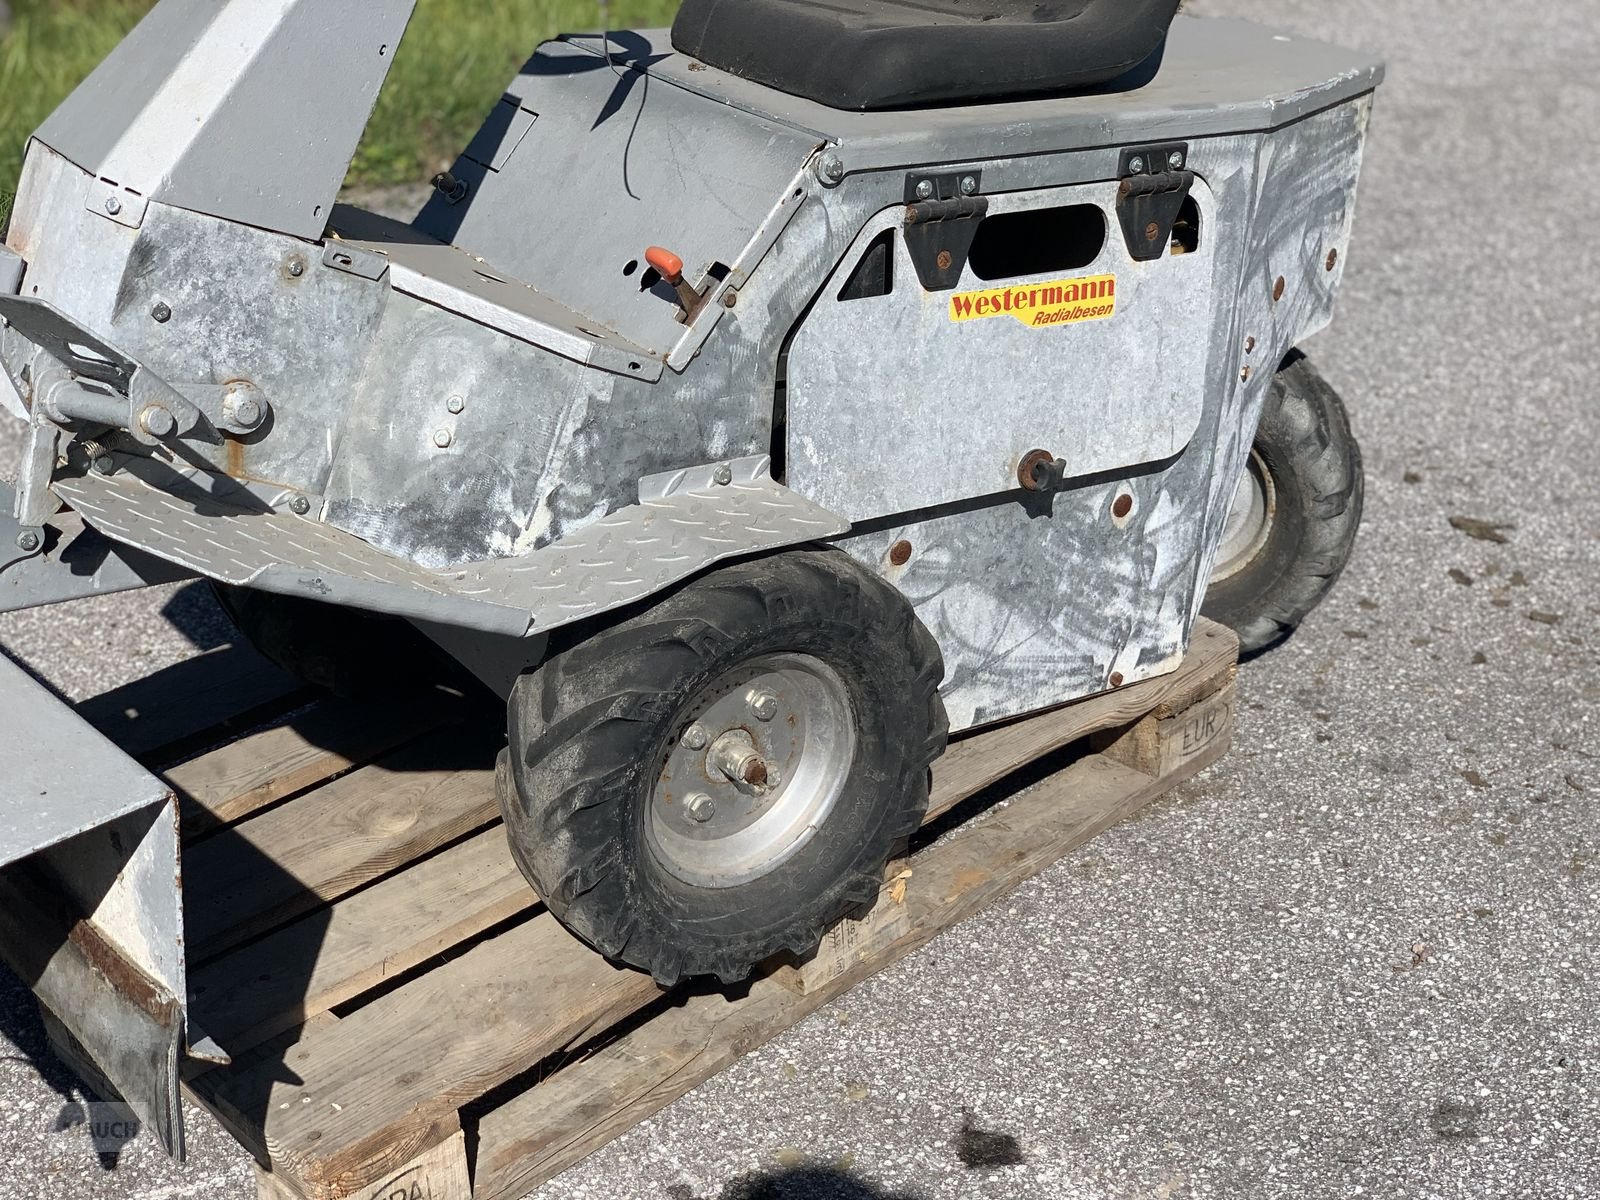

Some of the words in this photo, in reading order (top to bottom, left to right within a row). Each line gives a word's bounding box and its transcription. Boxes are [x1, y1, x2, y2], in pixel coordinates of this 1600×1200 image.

[952, 279, 1114, 319] Westermann
[1032, 303, 1114, 326] Radialbesen
[1182, 707, 1217, 751] EUR
